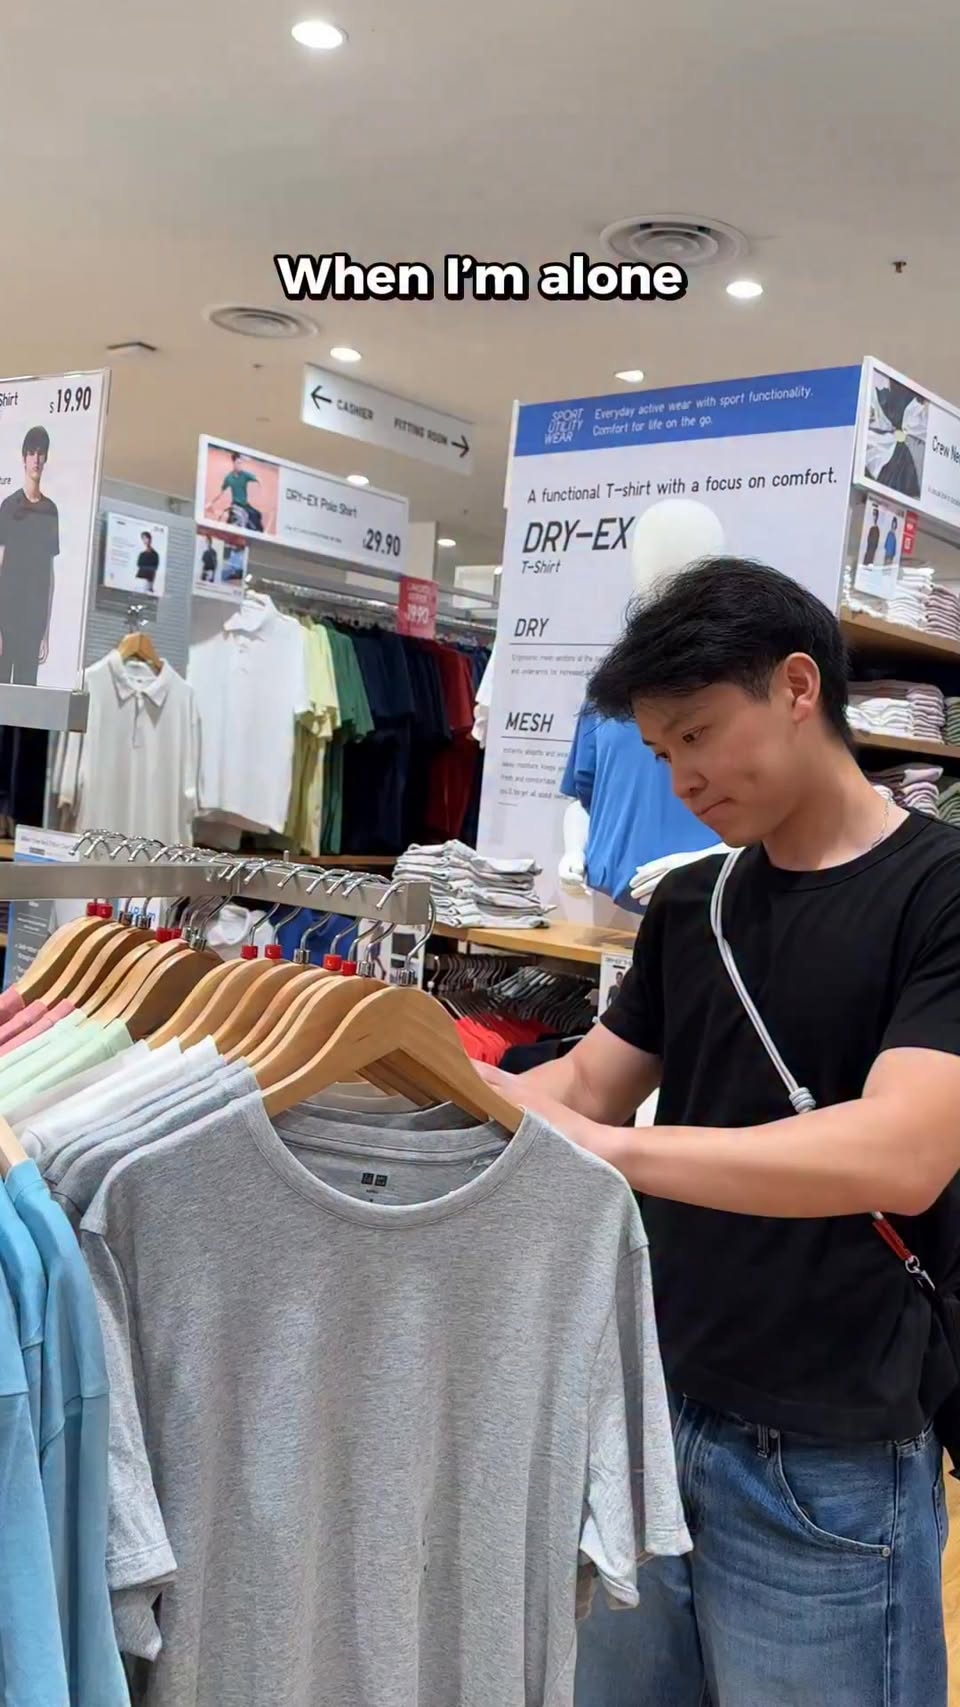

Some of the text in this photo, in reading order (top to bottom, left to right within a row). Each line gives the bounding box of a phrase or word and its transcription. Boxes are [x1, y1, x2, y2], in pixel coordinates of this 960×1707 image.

[552, 407, 584, 421] SPORT
[594, 386, 814, 421] Everyday active wear with sport functionality.
[337, 399, 448, 445] CASHIER FITTING ROOM
[548, 419, 584, 434] UTILITY
[592, 414, 712, 437] Comfort for life on the go.
[544, 431, 574, 445] WEAR
[932, 435, 950, 458] Crew
[527, 466, 838, 504] A functional T-shirt with a focus on comfort.
[286, 488, 357, 519] DRY-EX Polo Shirt
[522, 516, 636, 553] DRY-EX
[521, 560, 561, 574] T-Shirt
[514, 618, 549, 637] DRY
[505, 711, 554, 733] MESH
